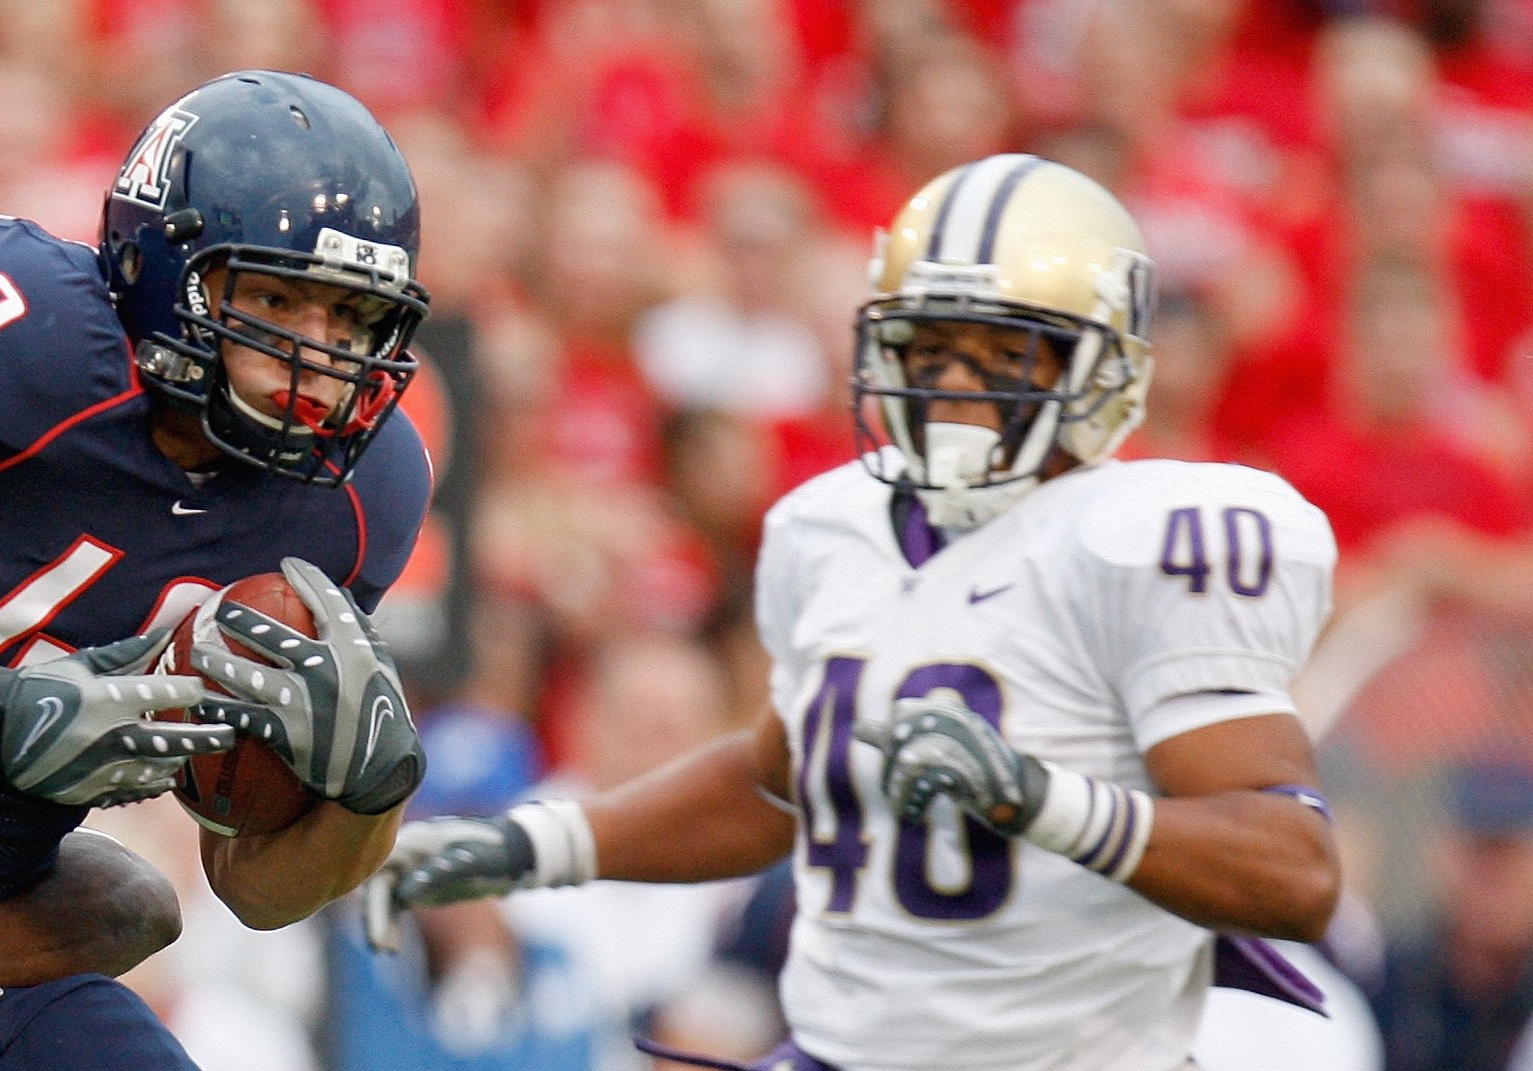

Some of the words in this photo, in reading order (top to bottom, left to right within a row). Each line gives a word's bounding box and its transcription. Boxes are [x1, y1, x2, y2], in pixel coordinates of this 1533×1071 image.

[112, 107, 199, 212] A
[1158, 505, 1274, 600] 40
[797, 655, 1016, 923] 40
